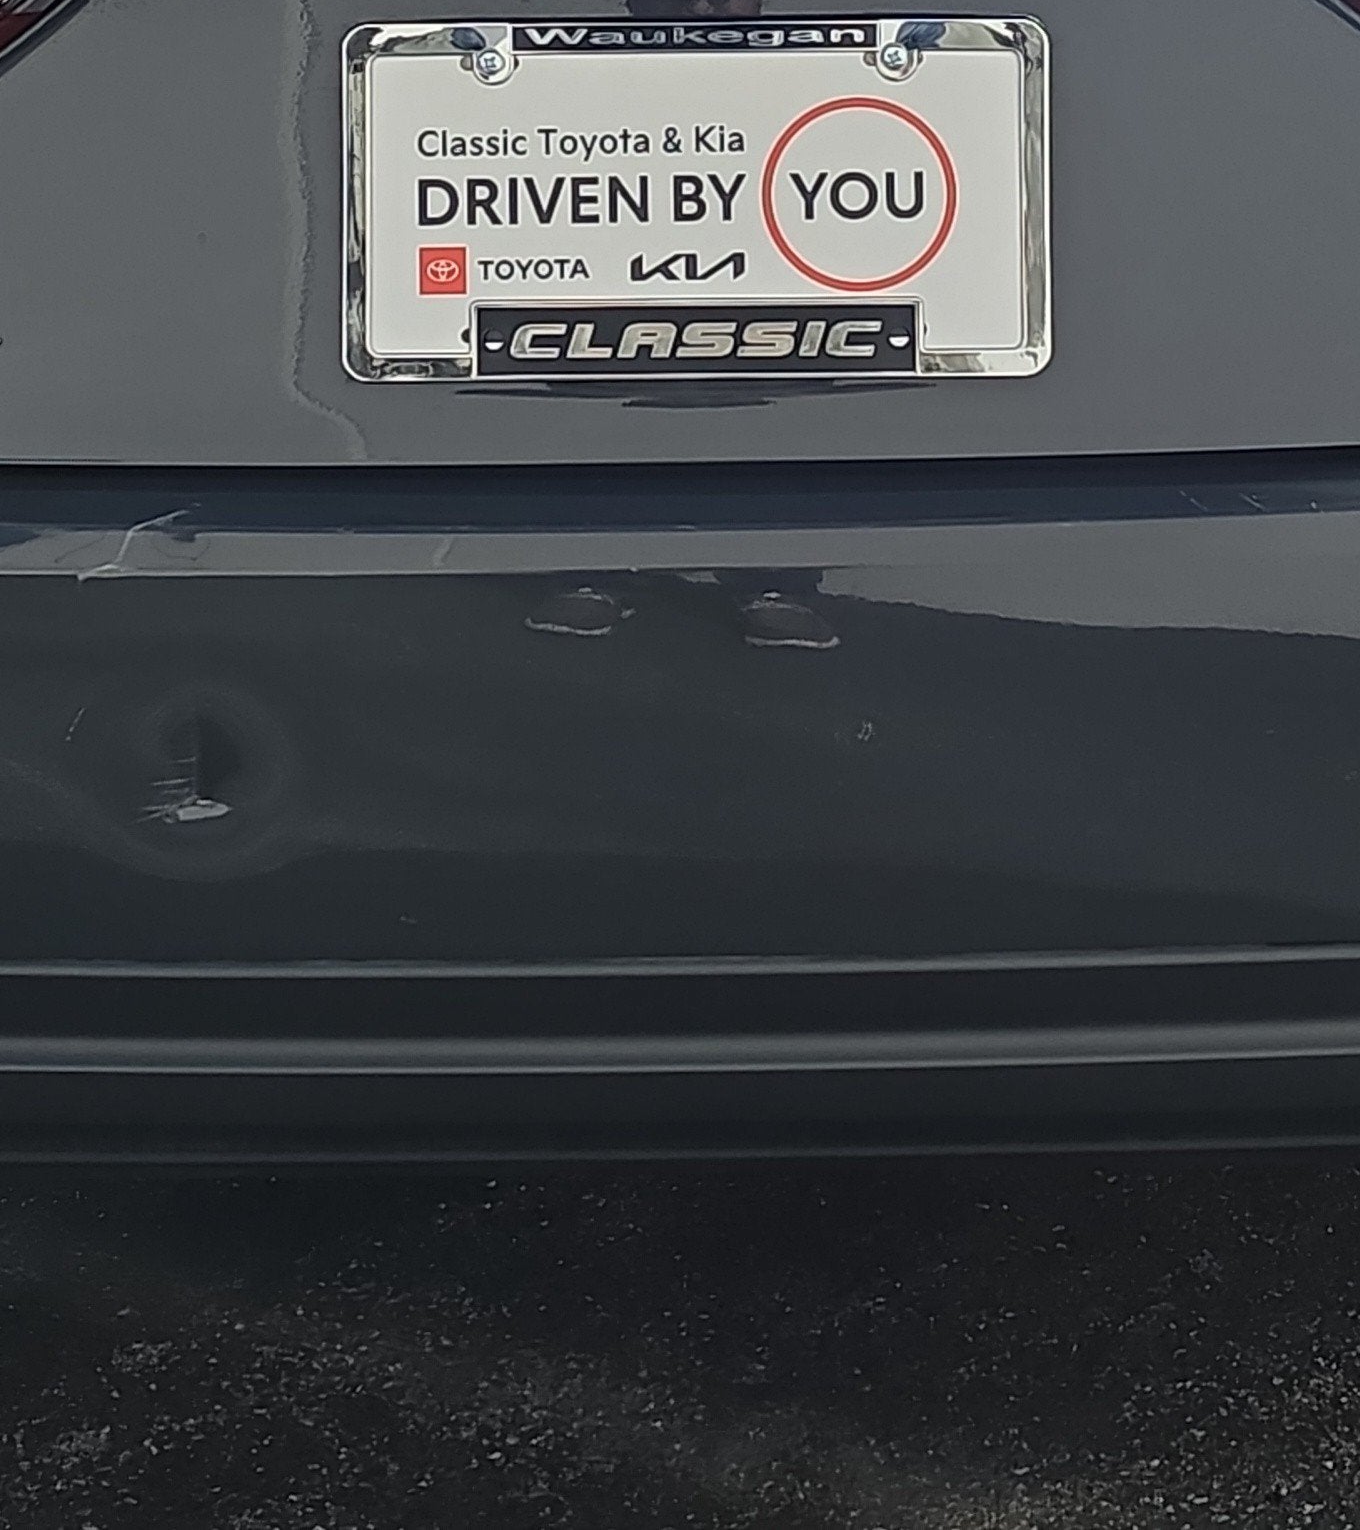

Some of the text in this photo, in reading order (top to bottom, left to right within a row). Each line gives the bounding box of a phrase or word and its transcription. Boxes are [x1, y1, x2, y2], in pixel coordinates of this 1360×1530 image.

[522, 24, 866, 50] Waukegan
[416, 125, 746, 161] Classic Toyota & Kia
[417, 170, 926, 226] DRIVEN BY YOU
[478, 258, 590, 282] TOYOTA
[508, 320, 883, 360] CLASSIC
